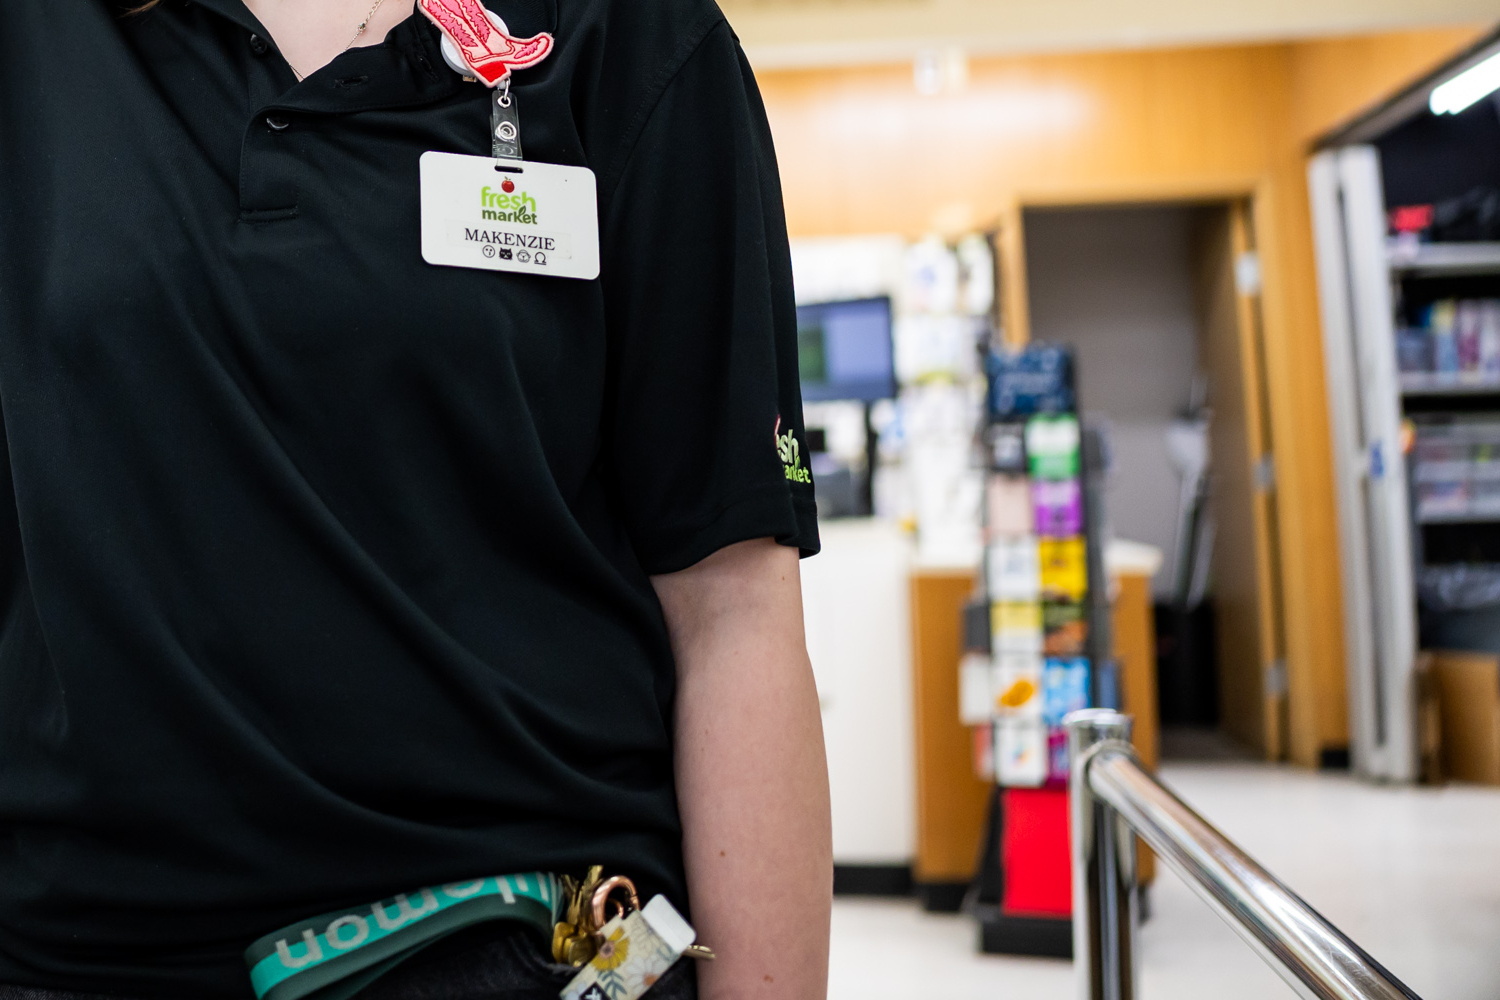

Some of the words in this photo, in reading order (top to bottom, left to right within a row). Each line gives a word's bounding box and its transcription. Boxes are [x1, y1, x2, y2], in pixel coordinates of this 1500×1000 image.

[481, 185, 537, 213] fresh
[481, 206, 538, 226] market
[464, 228, 556, 251] MAKENZIE
[775, 428, 799, 464] esh
[783, 461, 811, 484] arket
